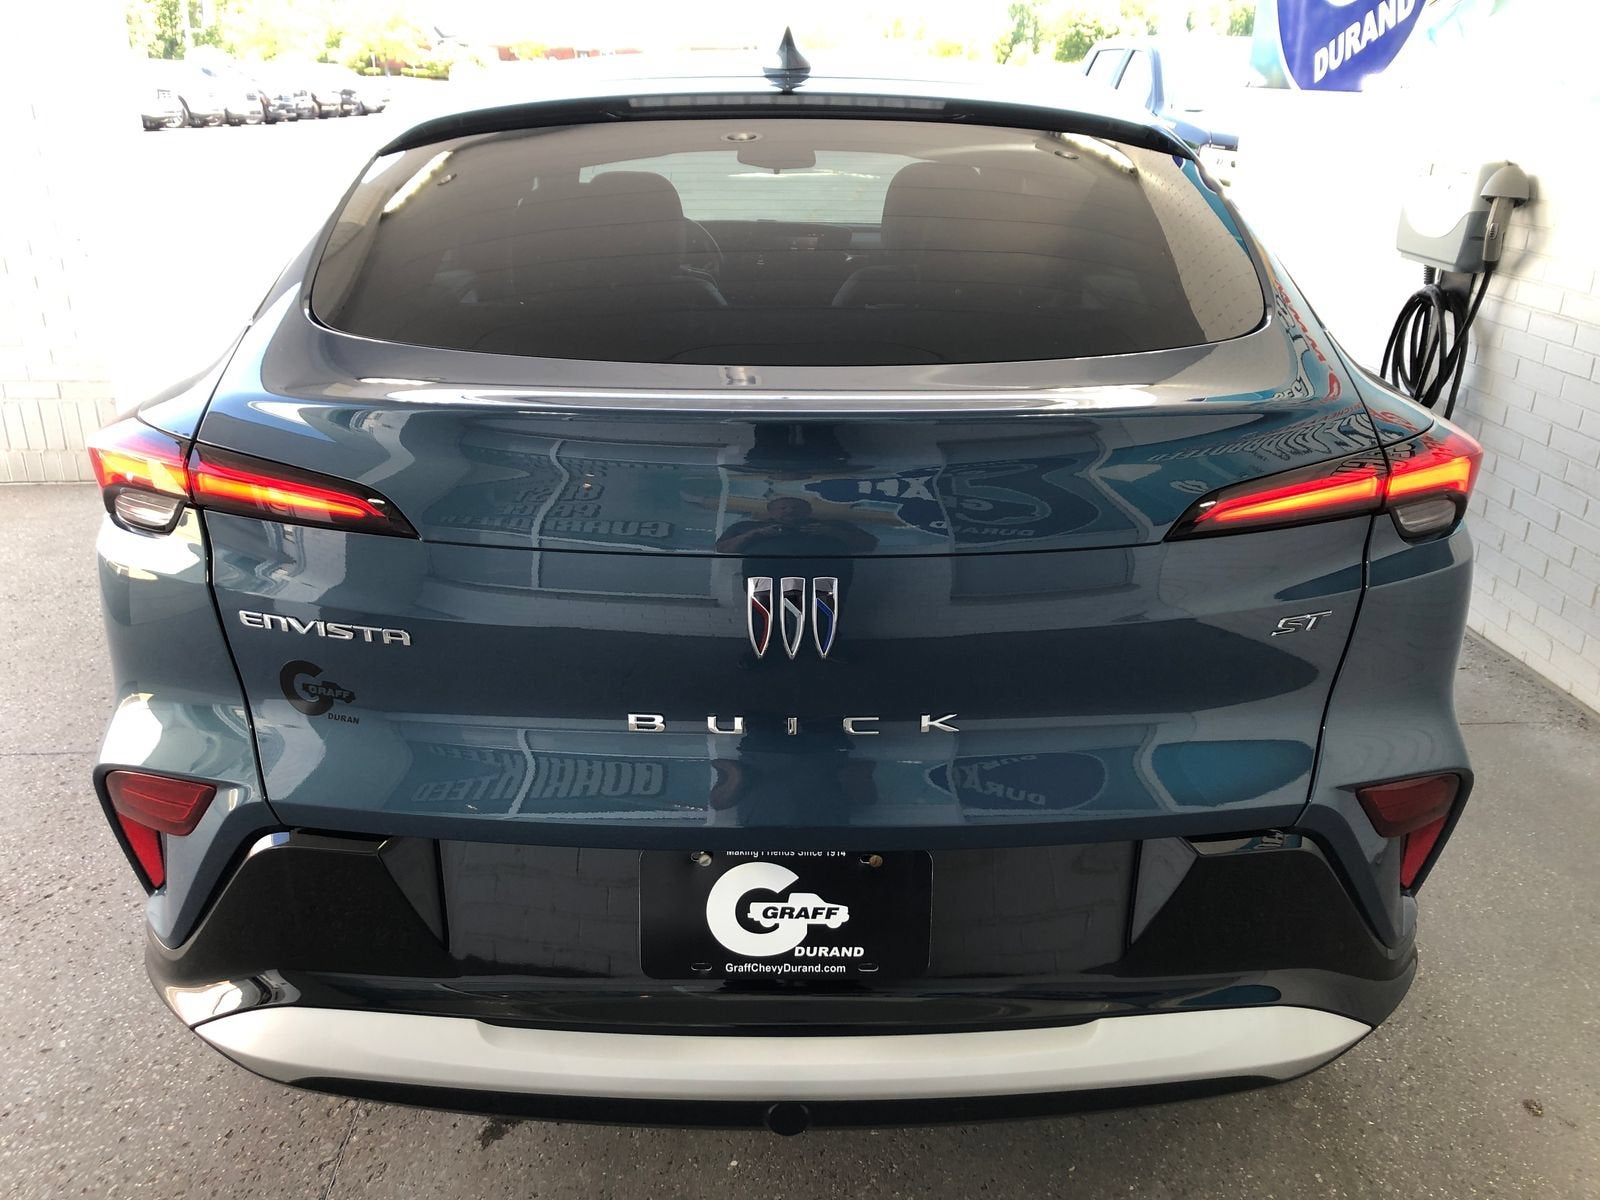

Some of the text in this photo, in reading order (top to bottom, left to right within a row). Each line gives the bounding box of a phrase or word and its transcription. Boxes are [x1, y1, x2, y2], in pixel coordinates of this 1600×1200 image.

[1314, 0, 1416, 84] DURAND
[238, 609, 412, 646] ENVISTA
[1271, 609, 1332, 637] ST
[308, 685, 351, 699] GRAFF
[328, 712, 360, 725] DURAN
[627, 713, 960, 736] BUICK
[762, 906, 840, 921] GRAFF
[794, 946, 865, 957] DURAND
[725, 963, 846, 974] GraffChevyDurand.com
